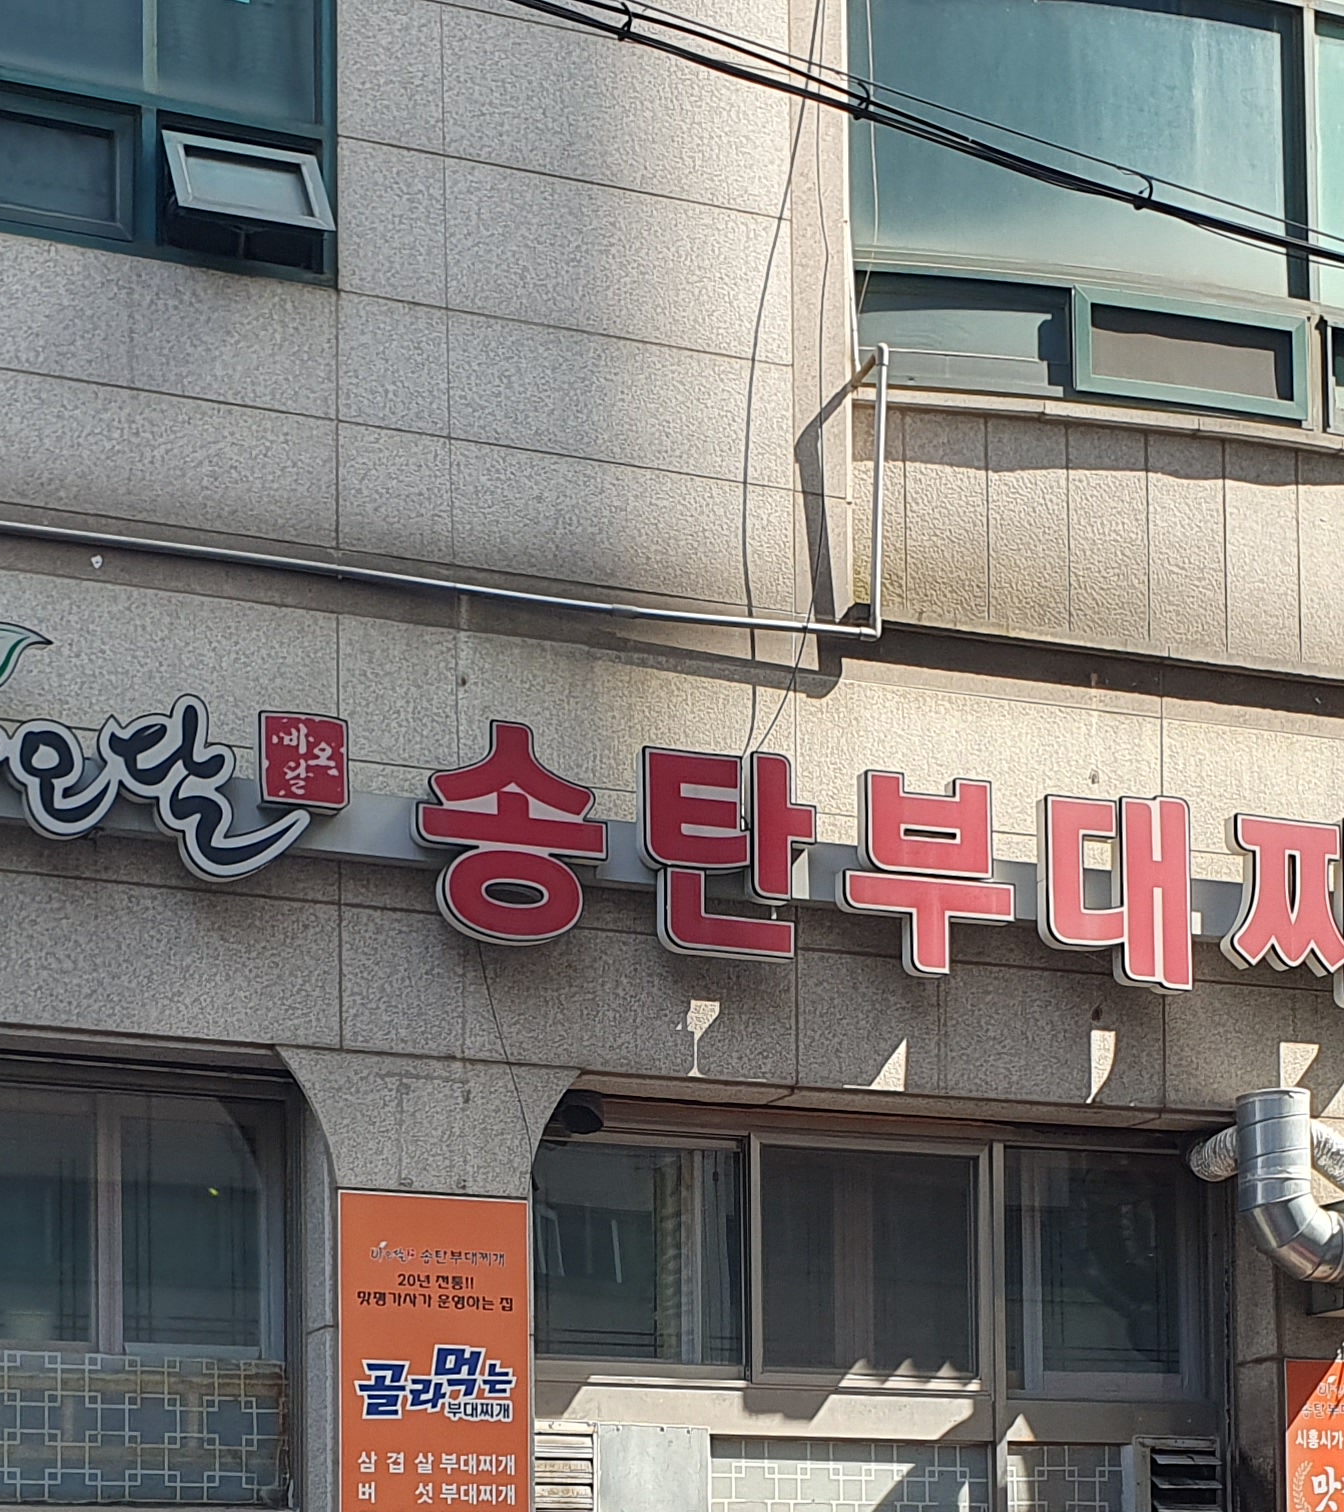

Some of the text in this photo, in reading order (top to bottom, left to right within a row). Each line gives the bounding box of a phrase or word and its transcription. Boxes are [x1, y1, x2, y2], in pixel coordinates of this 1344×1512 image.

[419, 1249, 505, 1267] 송탄부대찌개
[397, 1273, 475, 1290] 20년 전통!!
[499, 1296, 514, 1312] 집
[355, 1345, 516, 1420] 골라먹는
[445, 1401, 512, 1421] 부대찌개
[1295, 1429, 1344, 1450] 시흥시가
[357, 1452, 516, 1476] 삼겹살 부대찌개
[357, 1482, 516, 1507] 버섯 부대찌개
